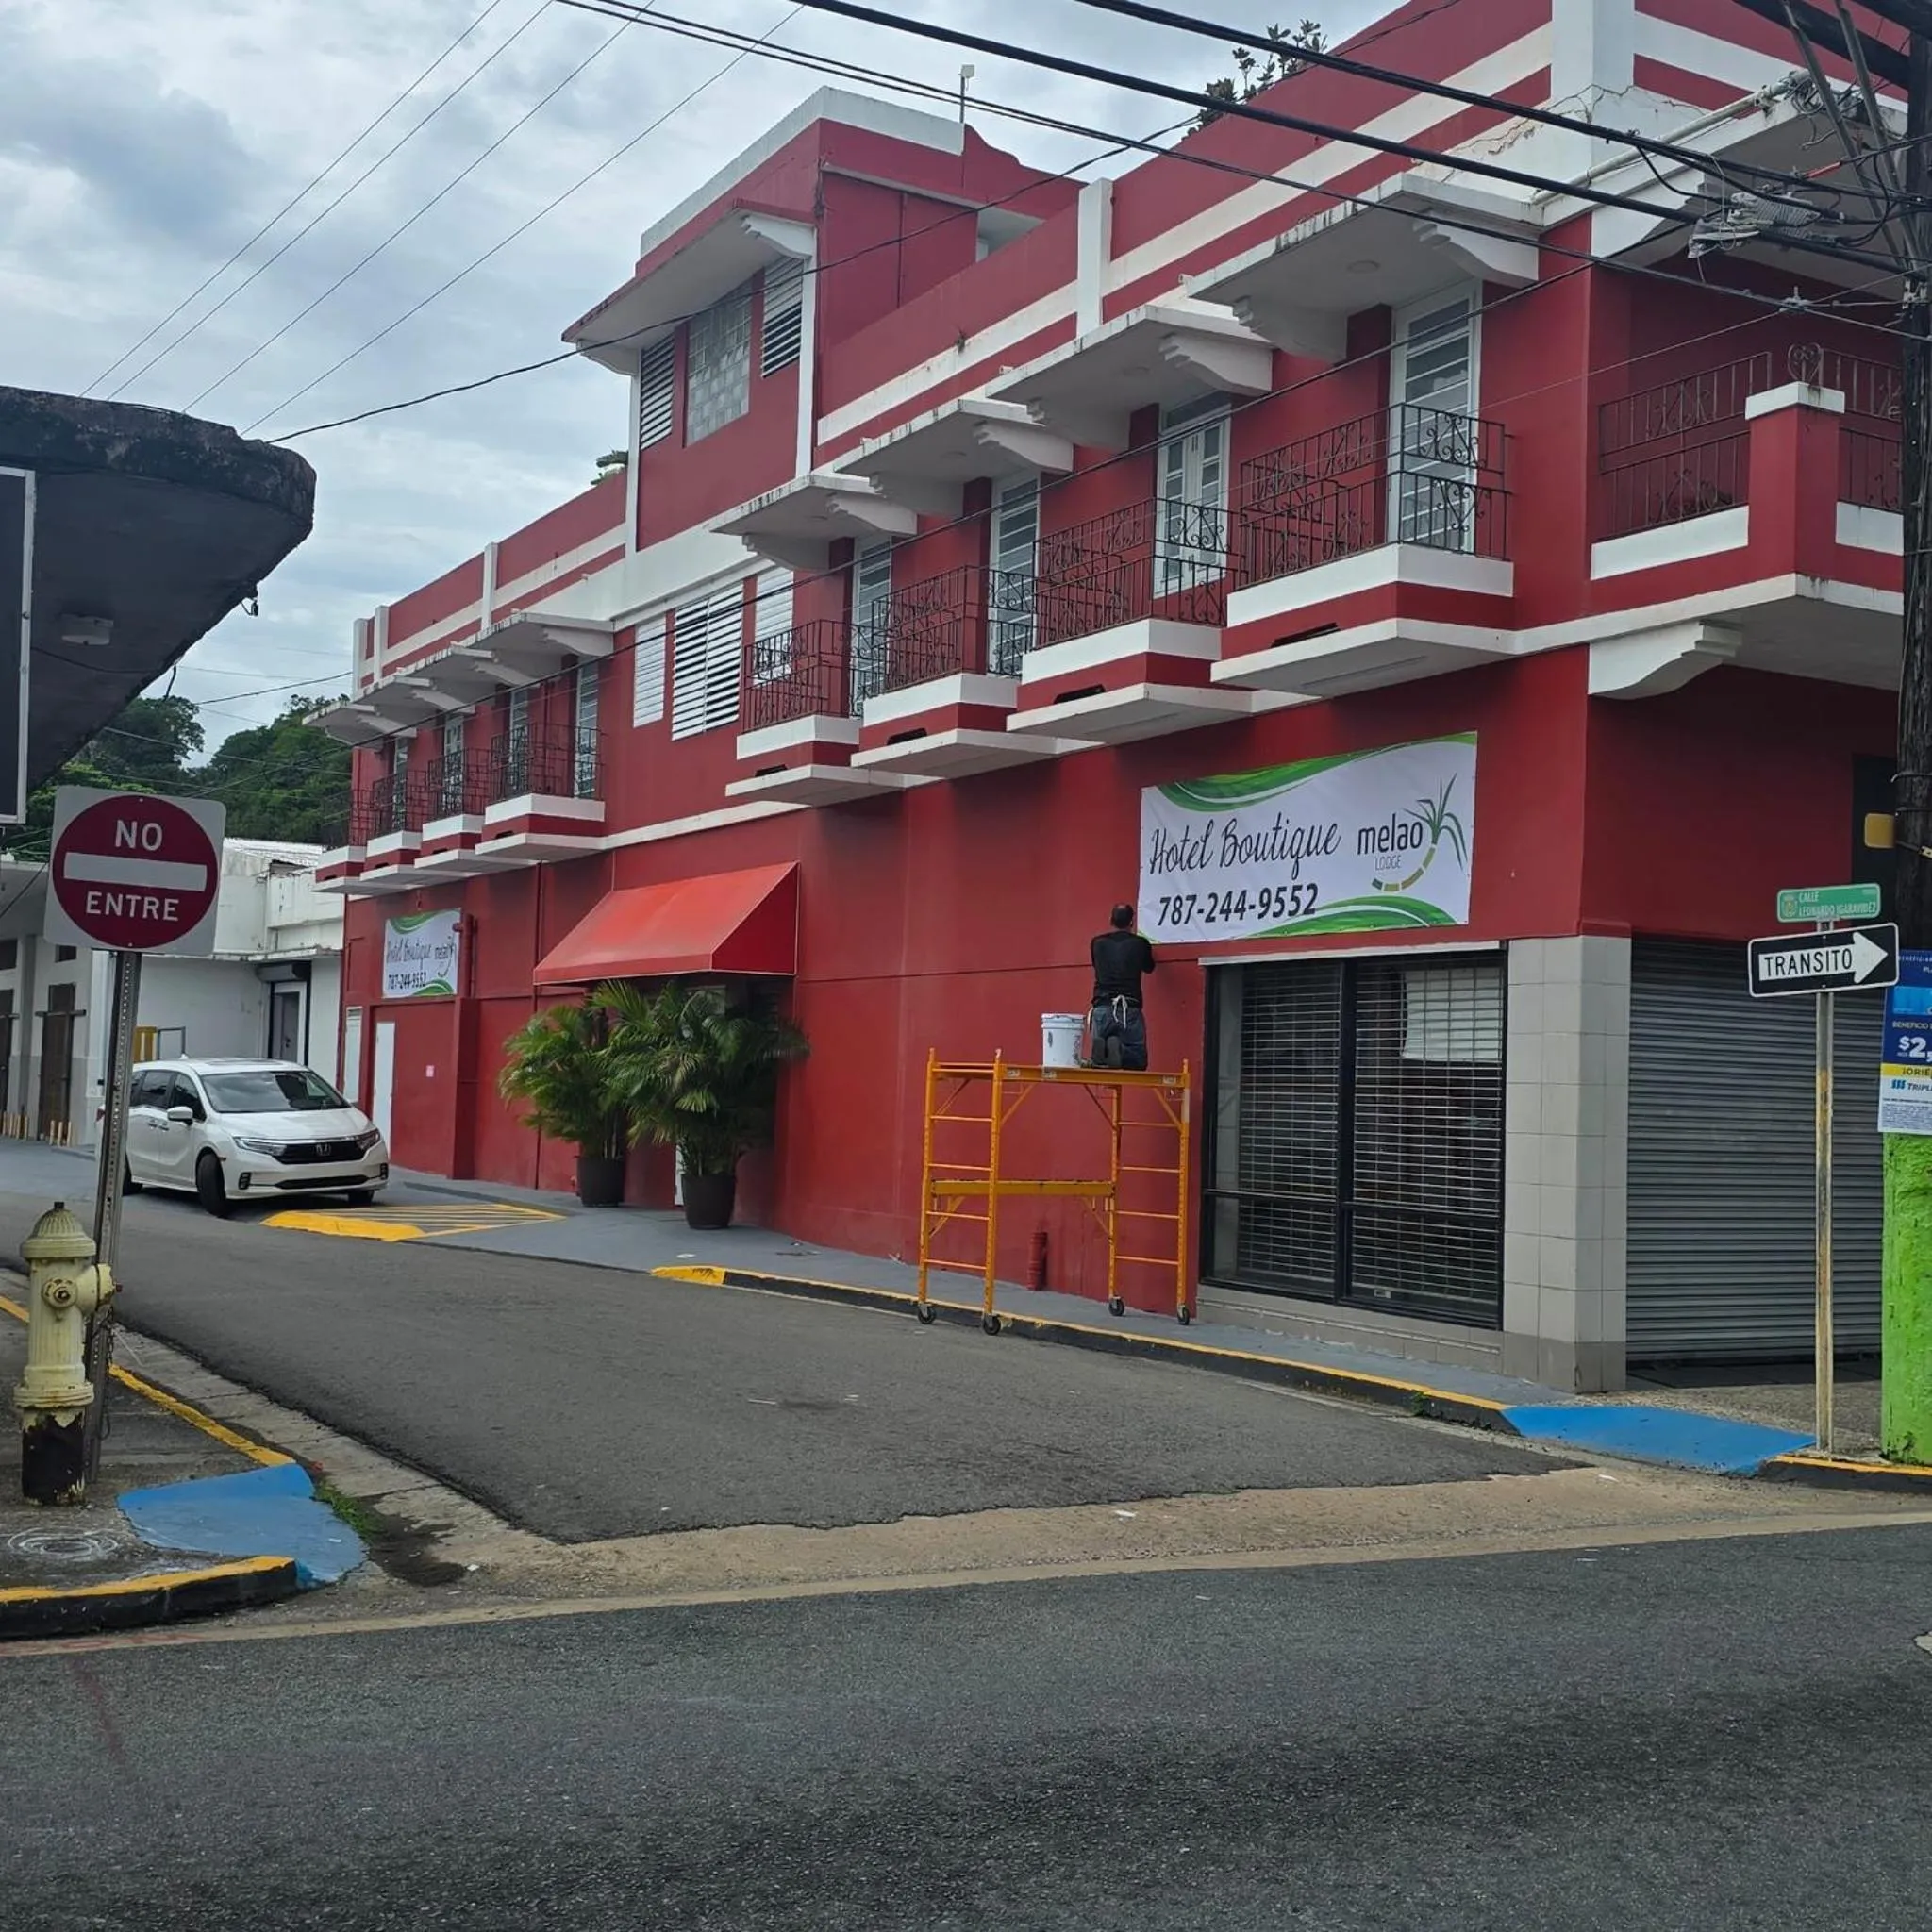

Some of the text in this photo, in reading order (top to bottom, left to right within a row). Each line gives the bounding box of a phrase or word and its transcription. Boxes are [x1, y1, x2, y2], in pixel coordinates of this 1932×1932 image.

[115, 819, 163, 851] NO
[1149, 811, 1341, 880] Hotel Boutique
[1357, 813, 1423, 856] melao
[1374, 855, 1402, 871] LODGE
[86, 891, 179, 922] ENTRE
[1158, 883, 1319, 926] 787-244-9552
[1799, 891, 1820, 903] CALLE
[1764, 948, 1853, 978] TRANSITO
[1892, 1021, 1928, 1030] BENEFICIO
